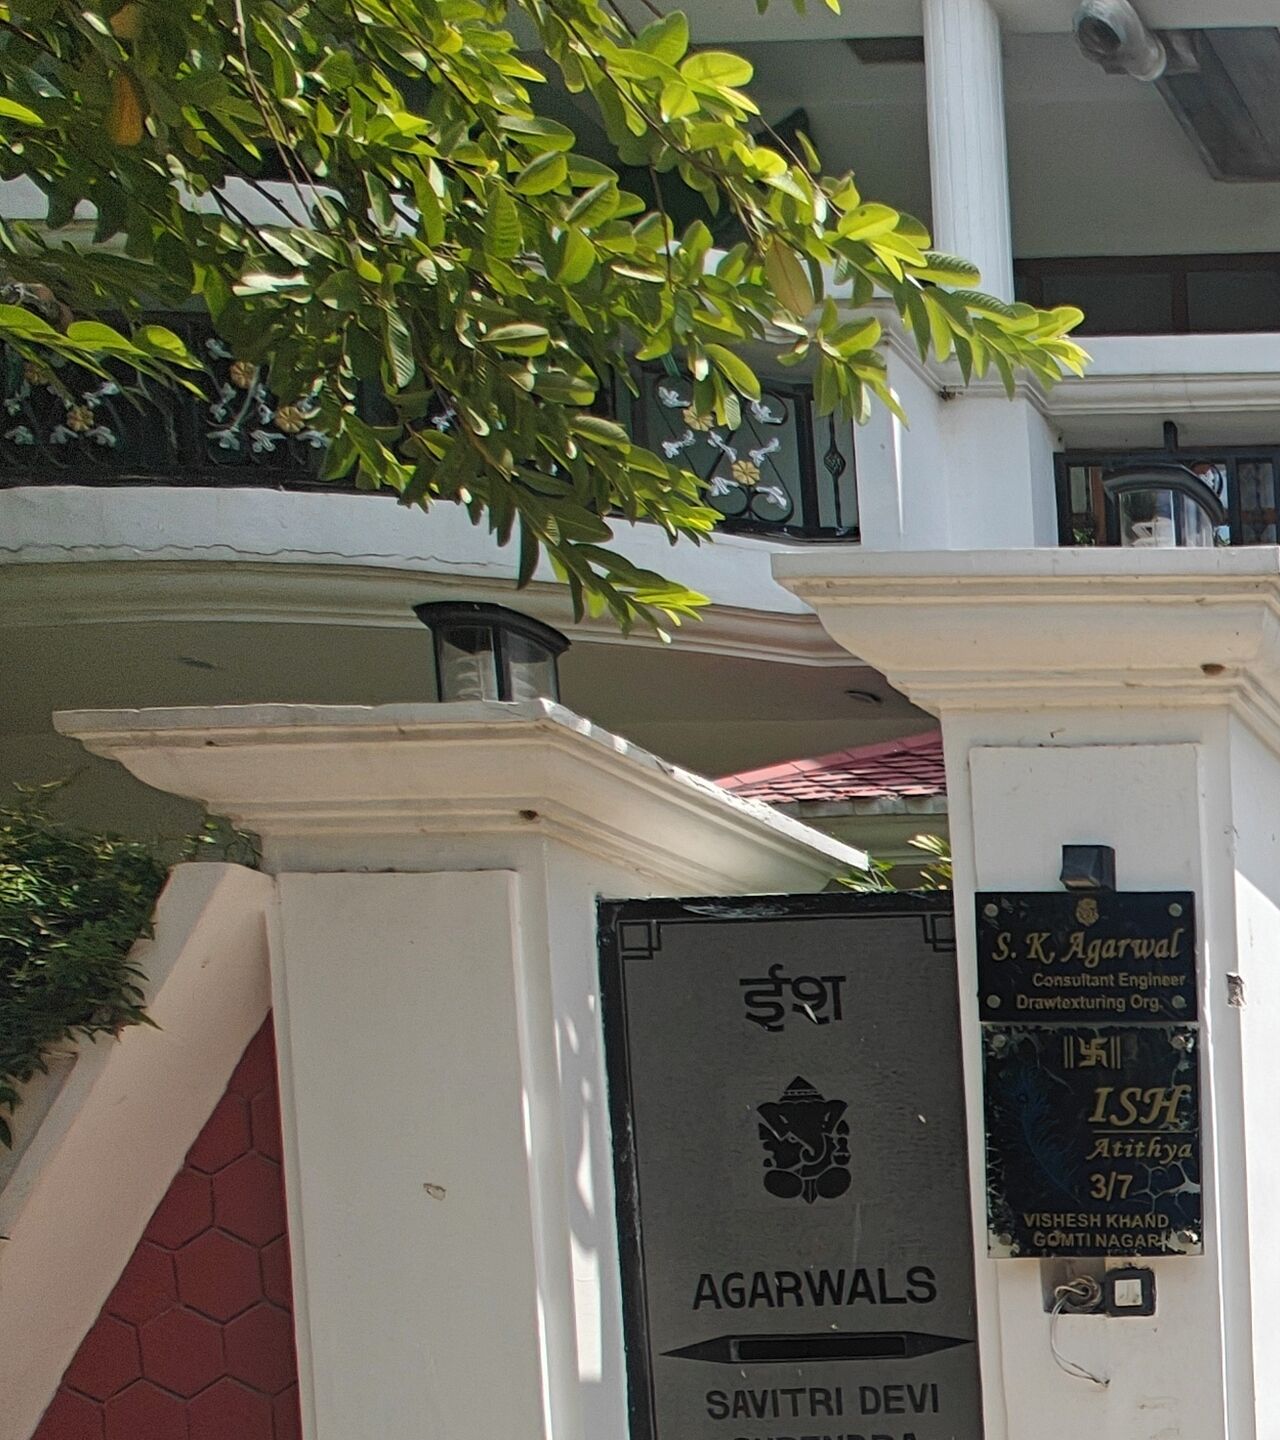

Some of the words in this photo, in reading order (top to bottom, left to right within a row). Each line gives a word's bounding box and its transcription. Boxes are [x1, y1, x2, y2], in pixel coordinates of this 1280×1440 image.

[991, 932, 1017, 961] S.
[1060, 927, 1184, 968] Agarwal
[1033, 972, 1115, 988] Consultant
[1119, 972, 1187, 991] Engineer
[739, 963, 847, 1033] ईश
[1016, 994, 1126, 1012] Drawtexturing
[1130, 994, 1164, 1012] Org.
[1088, 1084, 1191, 1127] ISH
[1085, 1136, 1193, 1164] Atithya
[1089, 1171, 1133, 1202] 3/7
[1023, 1213, 1103, 1228] VISHESH
[1106, 1214, 1169, 1228] KHAND
[1033, 1232, 1091, 1248] GOMTI
[1095, 1232, 1160, 1248] NAGAR
[693, 1265, 938, 1310] AGARWALS
[706, 1387, 842, 1420] SAVITRI
[859, 1383, 939, 1416] DEVI
